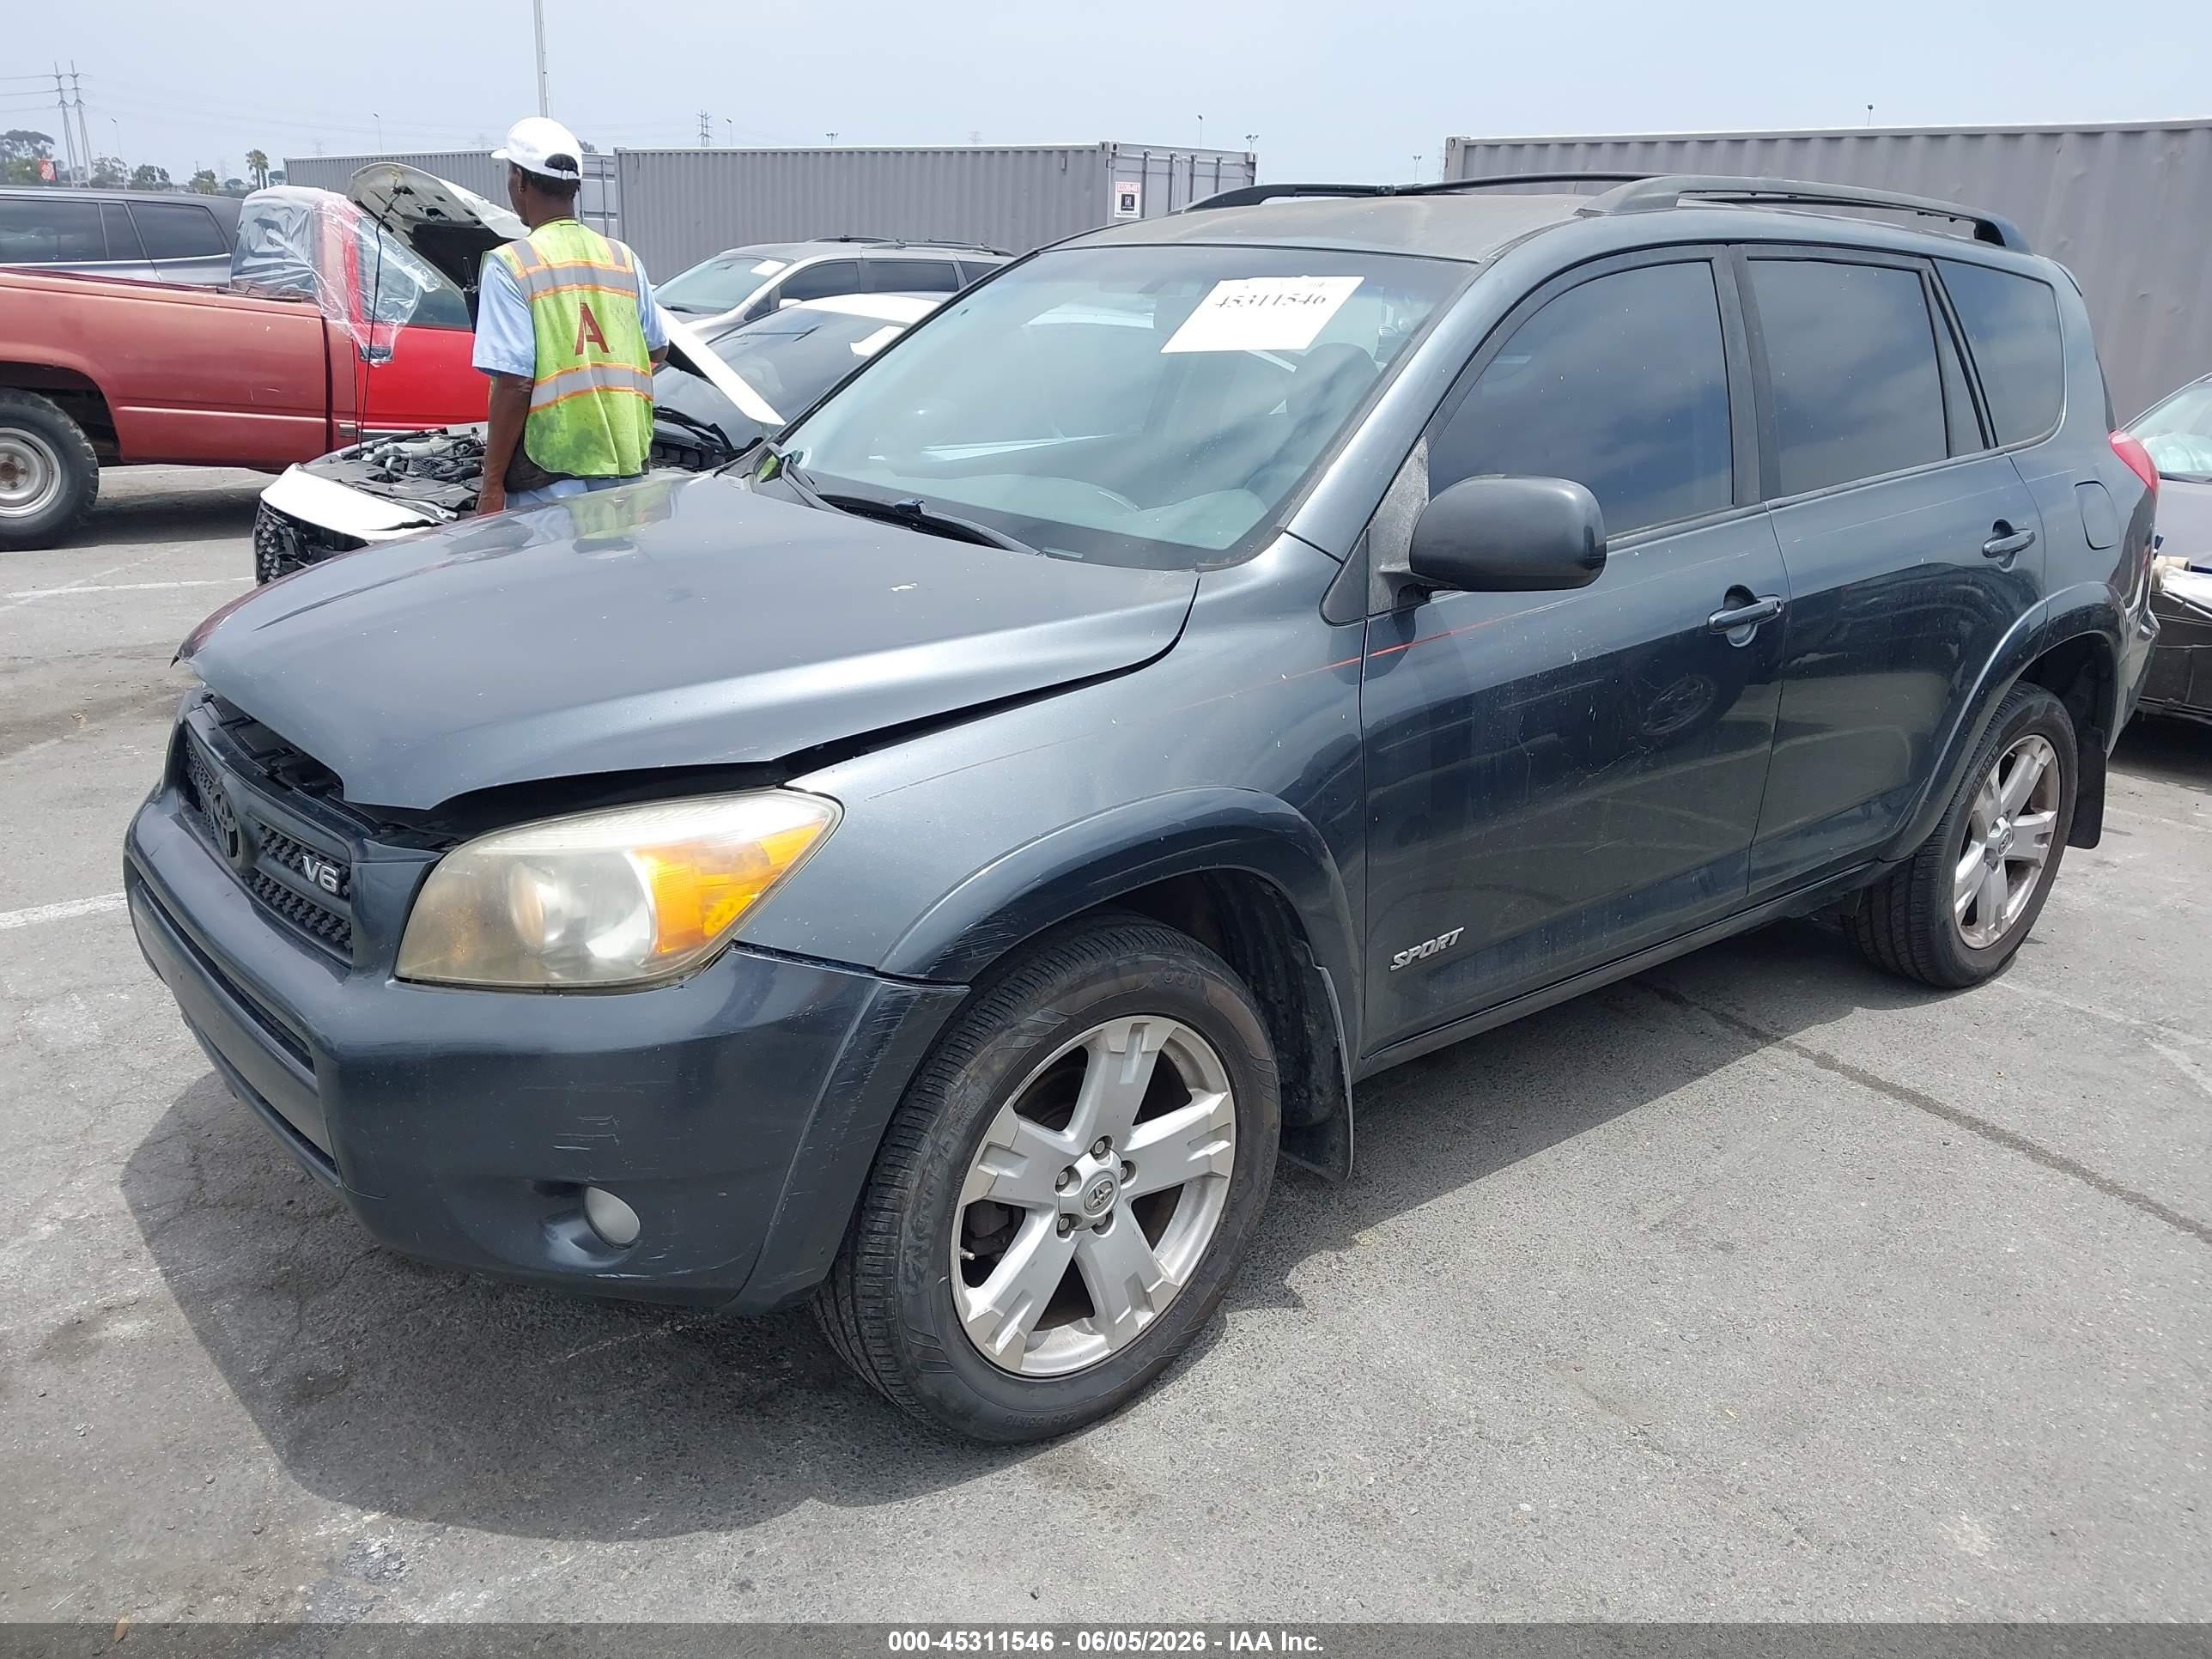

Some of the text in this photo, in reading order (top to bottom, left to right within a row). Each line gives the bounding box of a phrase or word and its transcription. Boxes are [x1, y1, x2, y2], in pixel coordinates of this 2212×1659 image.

[575, 302, 611, 356] A
[302, 855, 337, 893] V6
[1389, 927, 1466, 972] SPORT
